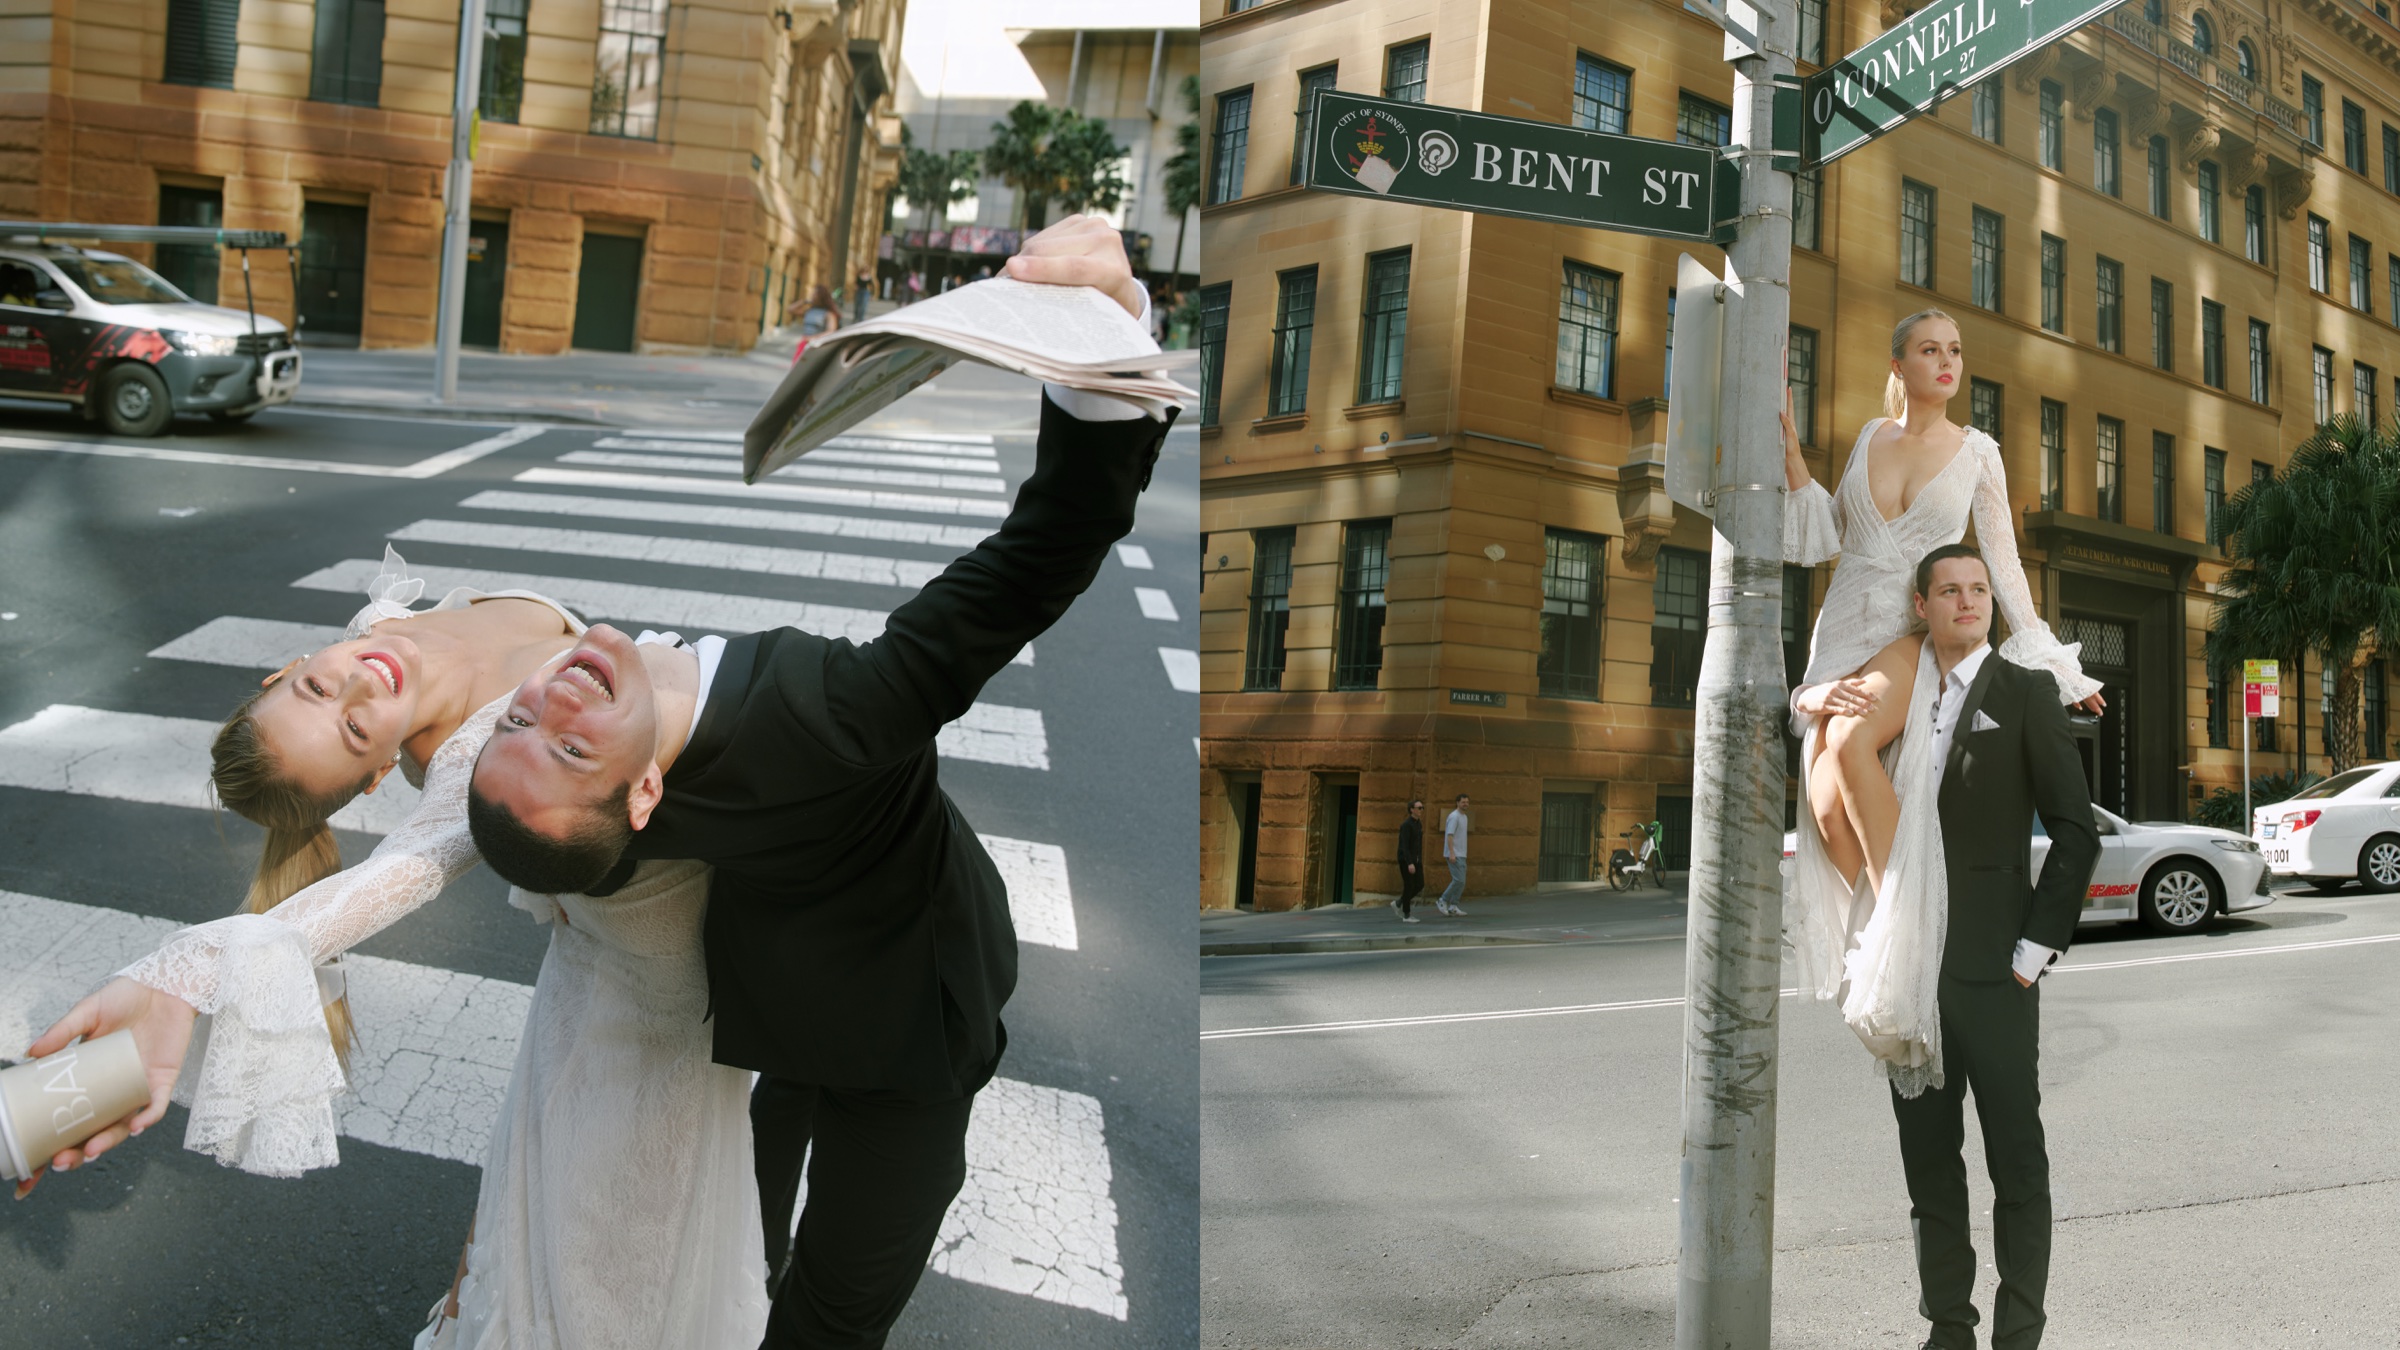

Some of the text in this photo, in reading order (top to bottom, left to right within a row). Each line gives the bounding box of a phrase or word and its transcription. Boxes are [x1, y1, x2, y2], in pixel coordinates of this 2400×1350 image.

[1813, 0, 1997, 125] O'CONNELL
[1928, 69, 1936, 92] 1
[1959, 46, 1977, 73] 27
[1338, 108, 1408, 135] CITY OF SYDNEY
[1470, 142, 1699, 210] BENT ST
[2122, 556, 2171, 575] AGRICULTURE
[1453, 692, 1479, 701] FARRER
